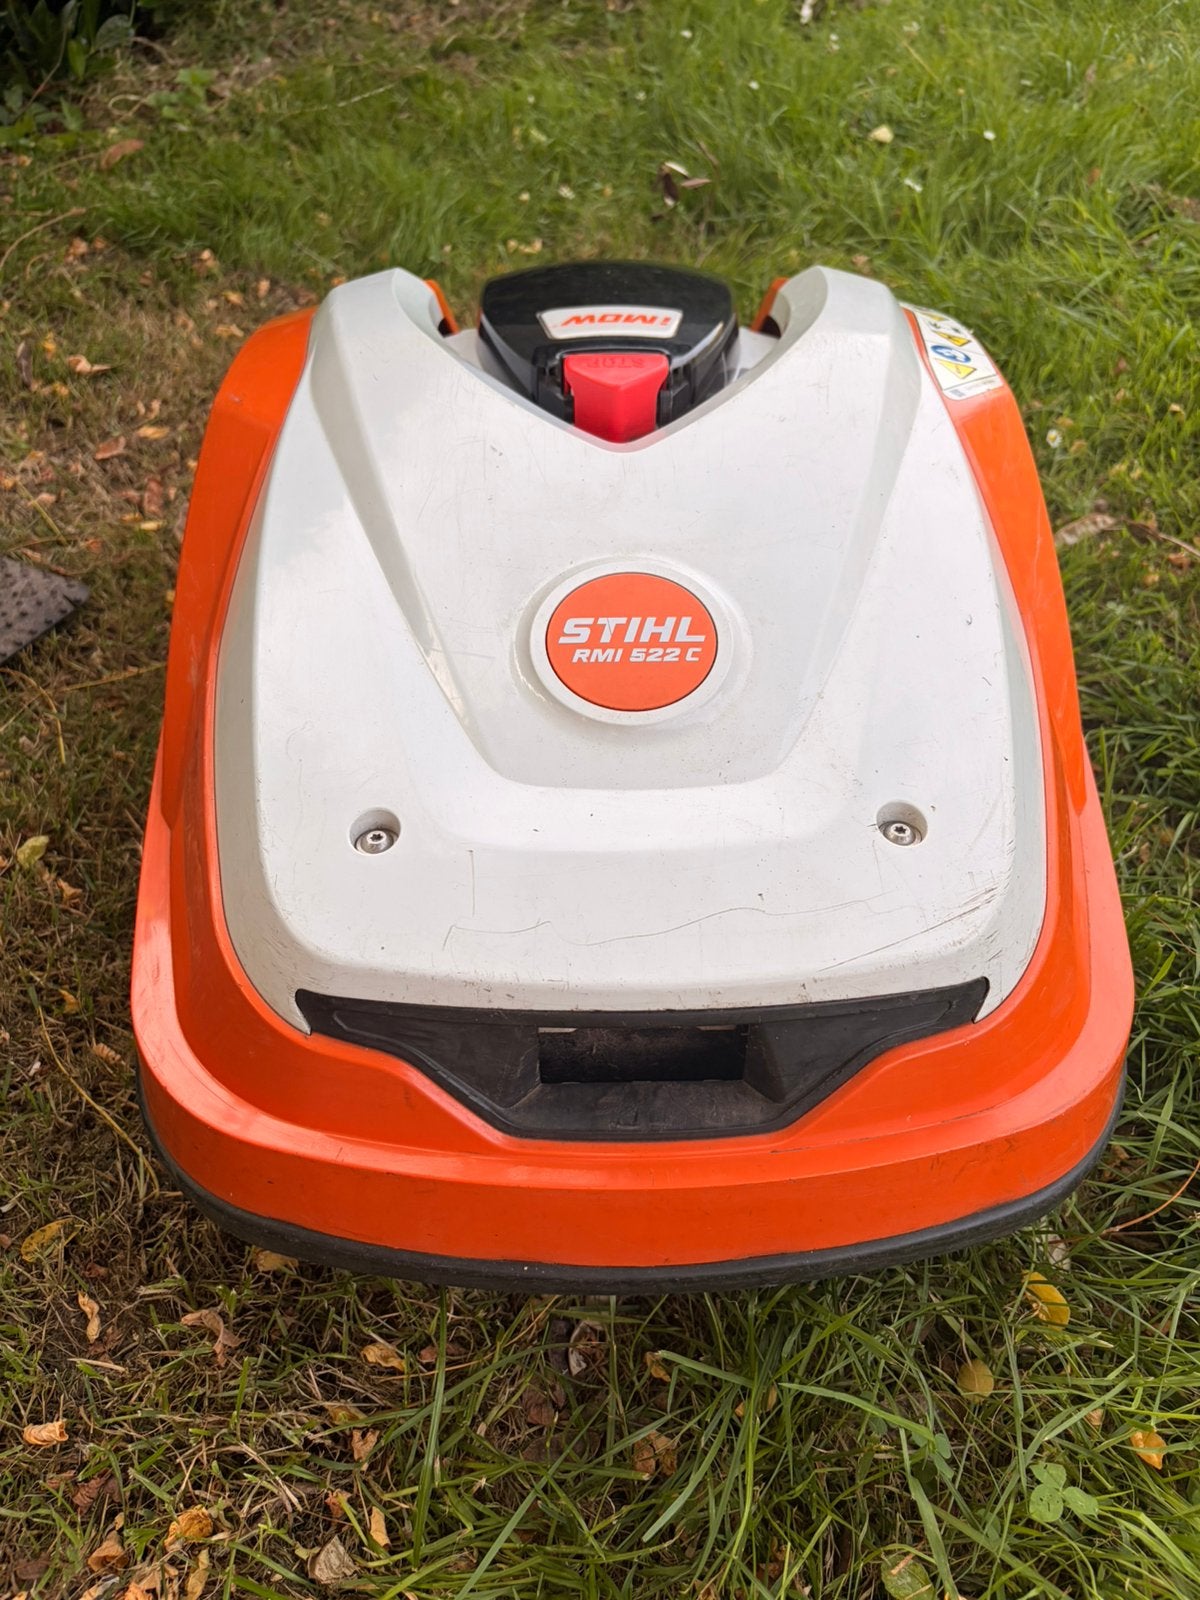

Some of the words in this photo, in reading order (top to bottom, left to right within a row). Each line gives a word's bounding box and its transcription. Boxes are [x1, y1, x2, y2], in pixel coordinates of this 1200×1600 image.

[587, 356, 645, 369] STOP
[558, 616, 706, 644] STIHL
[572, 648, 623, 663] RMI
[629, 647, 681, 662] 522
[685, 647, 702, 661] C
